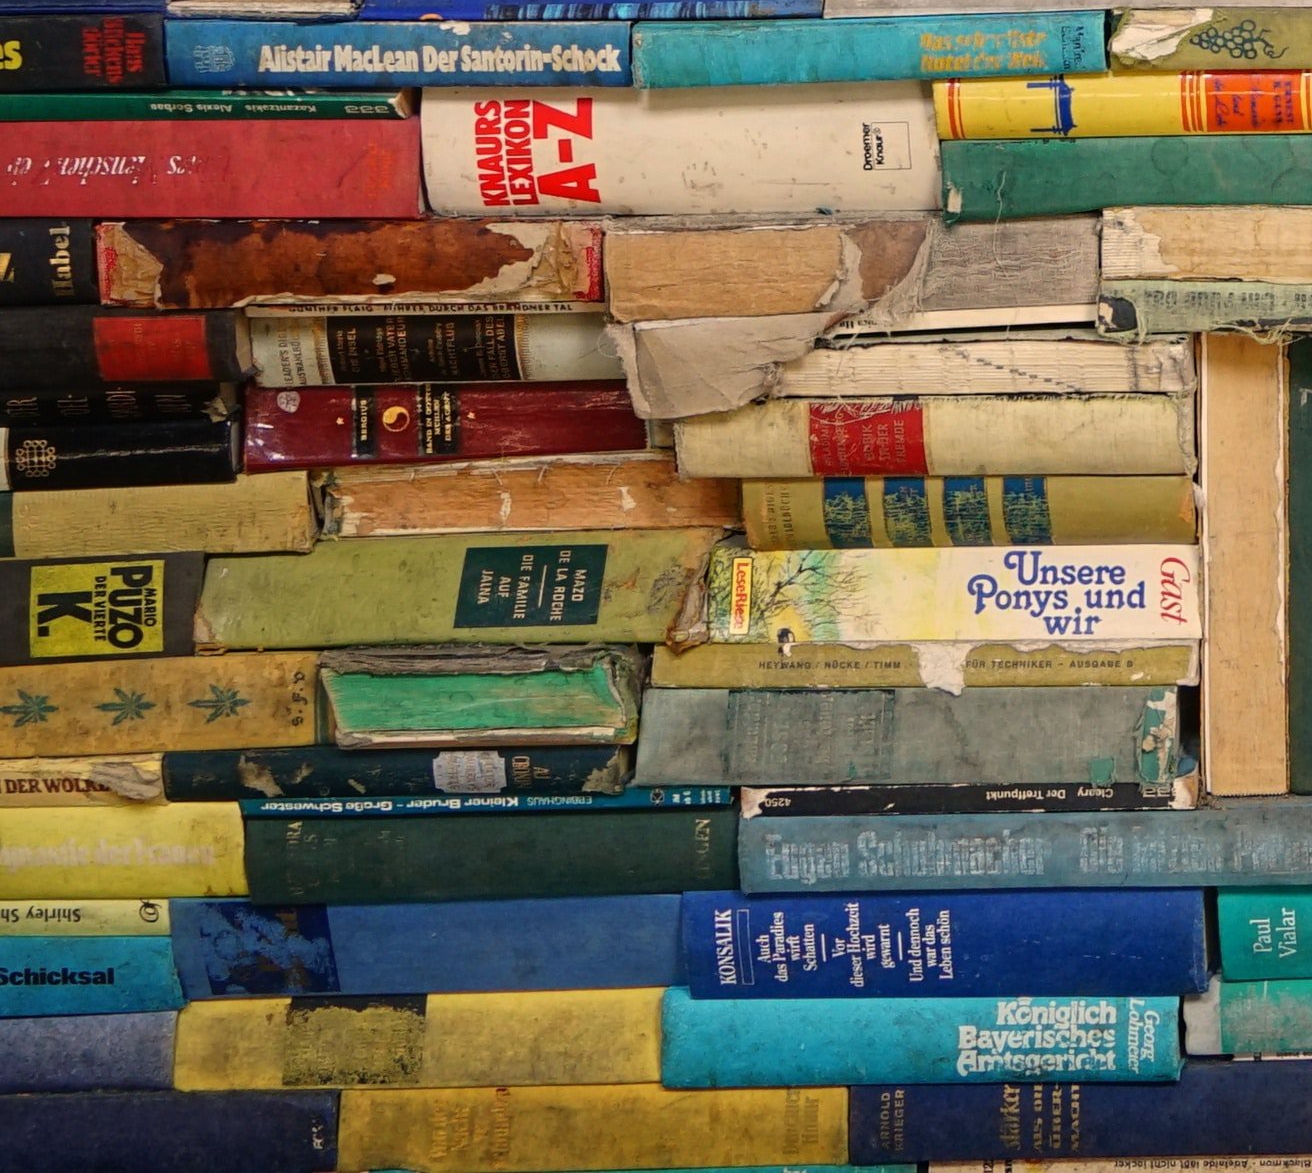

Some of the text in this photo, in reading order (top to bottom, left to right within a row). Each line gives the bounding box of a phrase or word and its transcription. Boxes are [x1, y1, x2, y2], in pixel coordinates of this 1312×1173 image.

[258, 44, 621, 73] Alistair MacLean Der Santorin-Schock
[475, 100, 510, 206] KNAURS
[504, 99, 539, 205] LEXIKON
[533, 98, 601, 203] A-Z
[498, 576, 510, 598] AUF
[513, 555, 533, 619] DIE FAMILIE
[550, 550, 571, 621] DE LA ROCHE
[572, 569, 587, 601] MAZO
[1004, 551, 1125, 585] Unsere
[94, 575, 106, 641] DER VIERTE
[108, 565, 153, 649] PUZO
[144, 589, 157, 627] MARIO
[967, 574, 1146, 617] Ponys und
[1160, 557, 1190, 625] Gast
[37, 591, 92, 637] K.
[1043, 607, 1102, 636] wir
[1249, 917, 1273, 954] Paul
[1276, 907, 1296, 959] Vialar
[959, 1026, 1116, 1055] Bayerisches
[957, 1049, 1116, 1077] Amtsgericht
